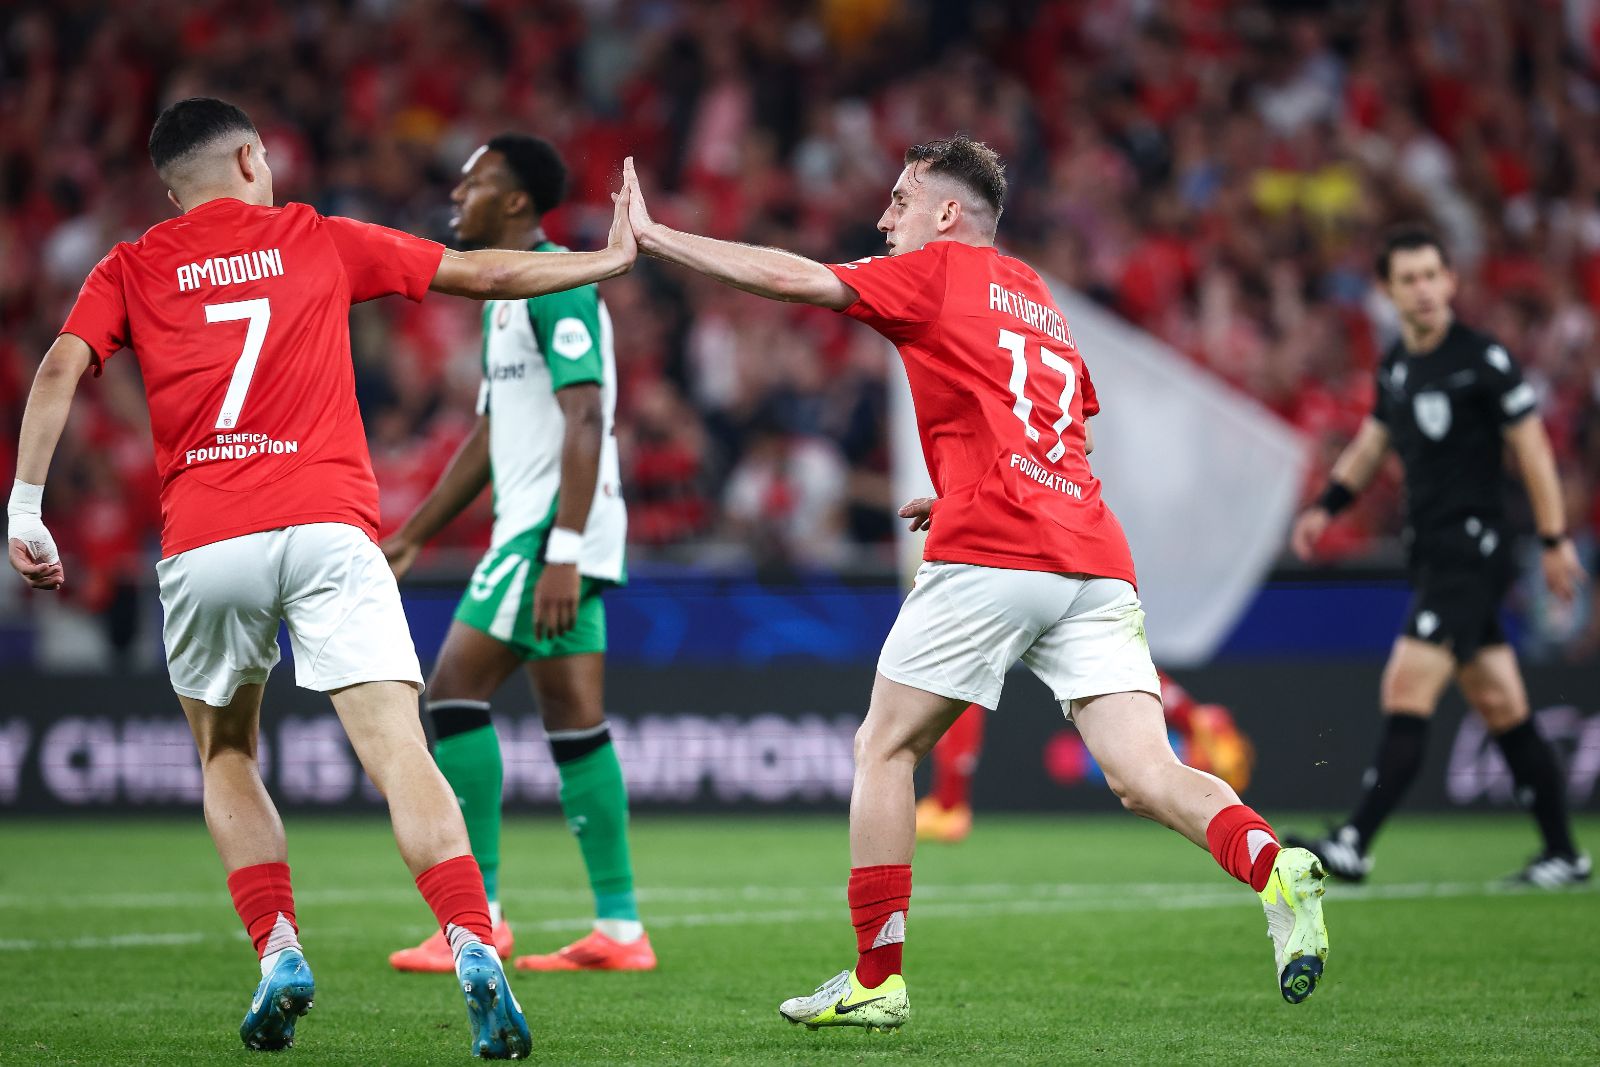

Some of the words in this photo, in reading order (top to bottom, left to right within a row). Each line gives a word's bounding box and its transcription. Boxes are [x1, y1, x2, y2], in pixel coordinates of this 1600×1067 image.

[176, 248, 284, 292] AMDOUNI
[204, 297, 271, 430] 7
[998, 328, 1076, 464] 17
[186, 439, 298, 465] FOUNDATION
[216, 433, 269, 445] BENFICA
[1010, 453, 1082, 501] FOUNDATION
